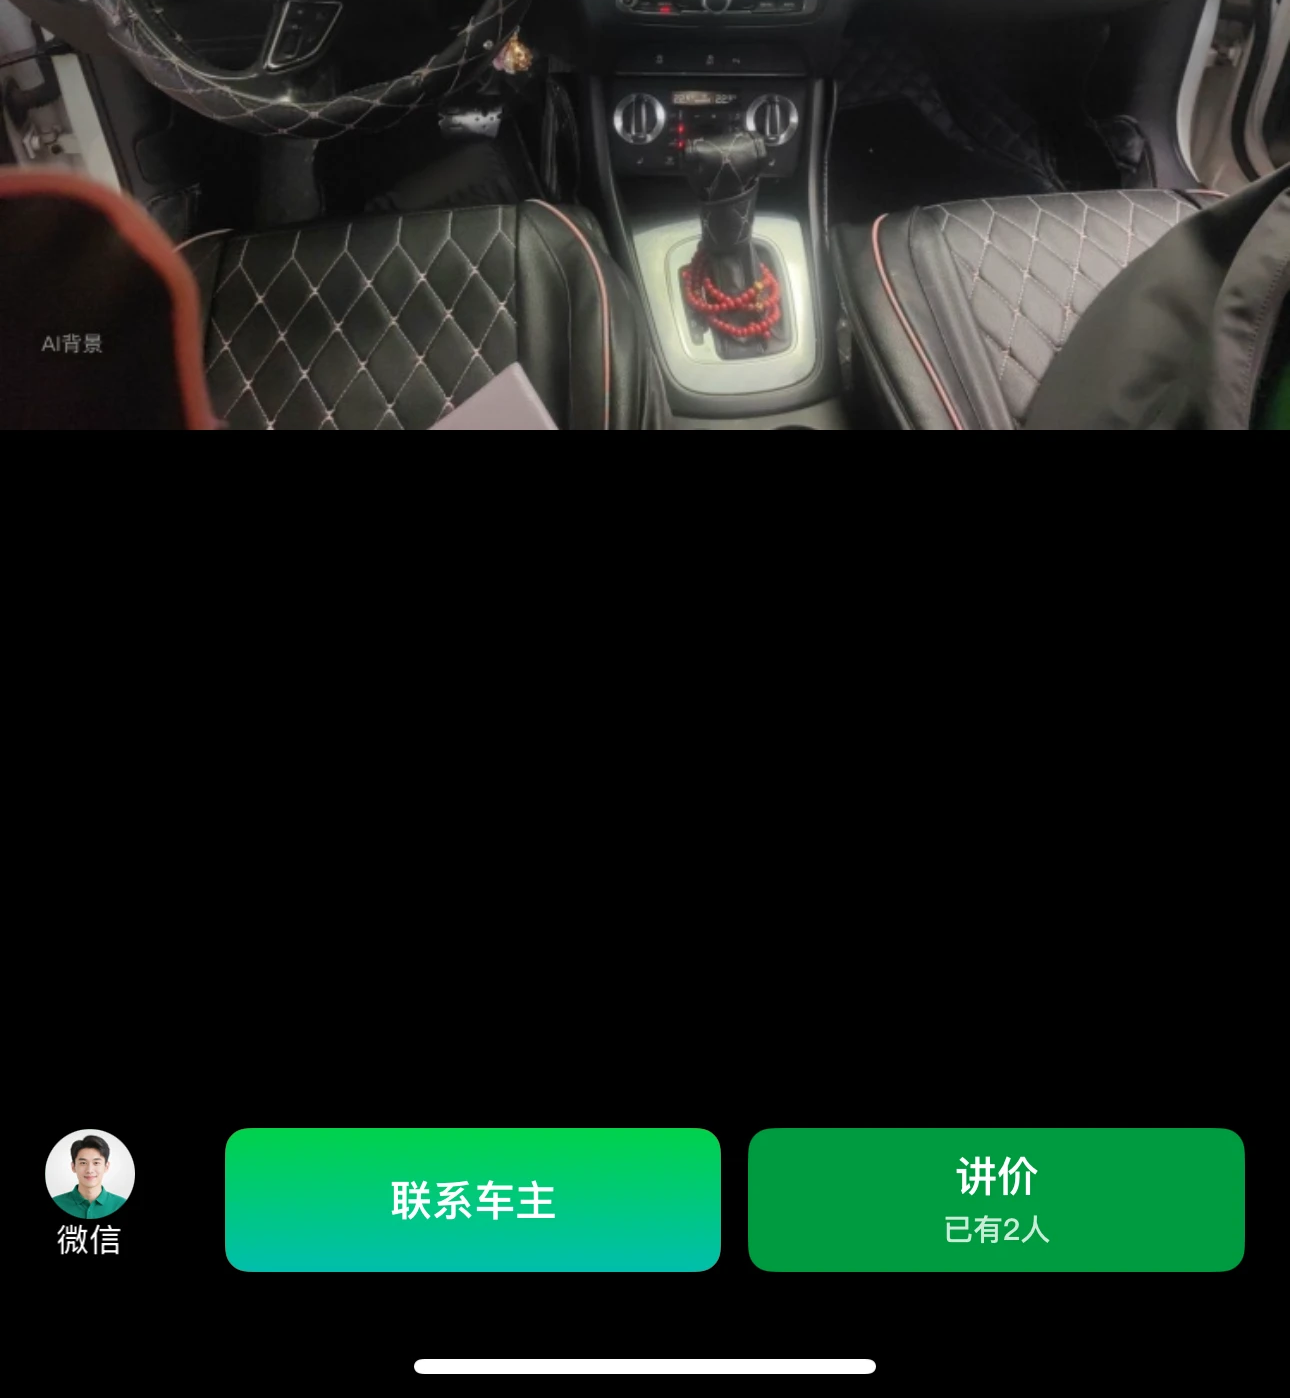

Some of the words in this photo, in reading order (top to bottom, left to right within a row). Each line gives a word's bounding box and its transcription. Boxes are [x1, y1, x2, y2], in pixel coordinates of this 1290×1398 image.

[956, 1155, 1038, 1197] 讲价
[391, 1179, 556, 1221] 联系车主
[57, 1224, 121, 1255] 微信
[945, 1214, 1050, 1244] 已有2人
